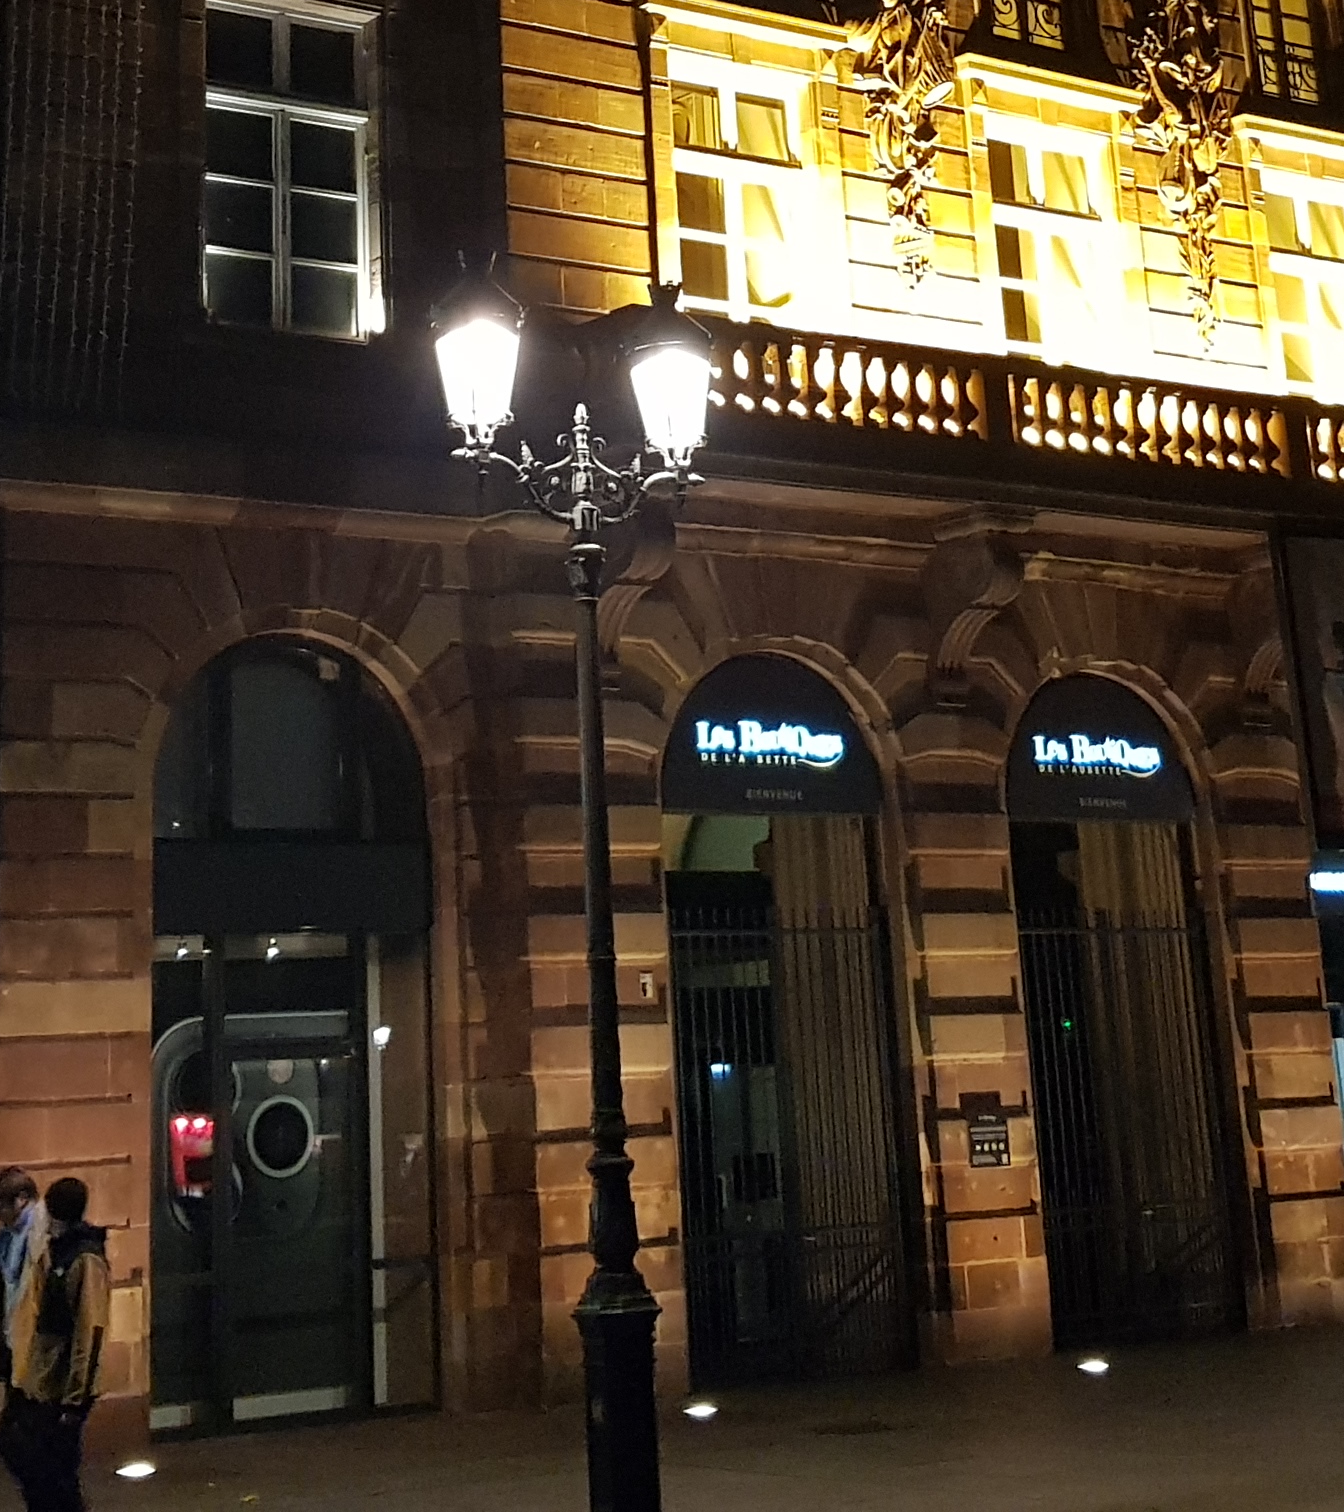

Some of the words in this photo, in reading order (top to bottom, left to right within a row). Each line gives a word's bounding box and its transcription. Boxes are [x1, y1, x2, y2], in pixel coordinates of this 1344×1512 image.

[1032, 734, 1068, 762] Les
[700, 752, 717, 762] DE
[724, 752, 797, 765] L'ABETTE
[1038, 765, 1053, 774] DE
[1059, 765, 1122, 776] L'AUBETTE
